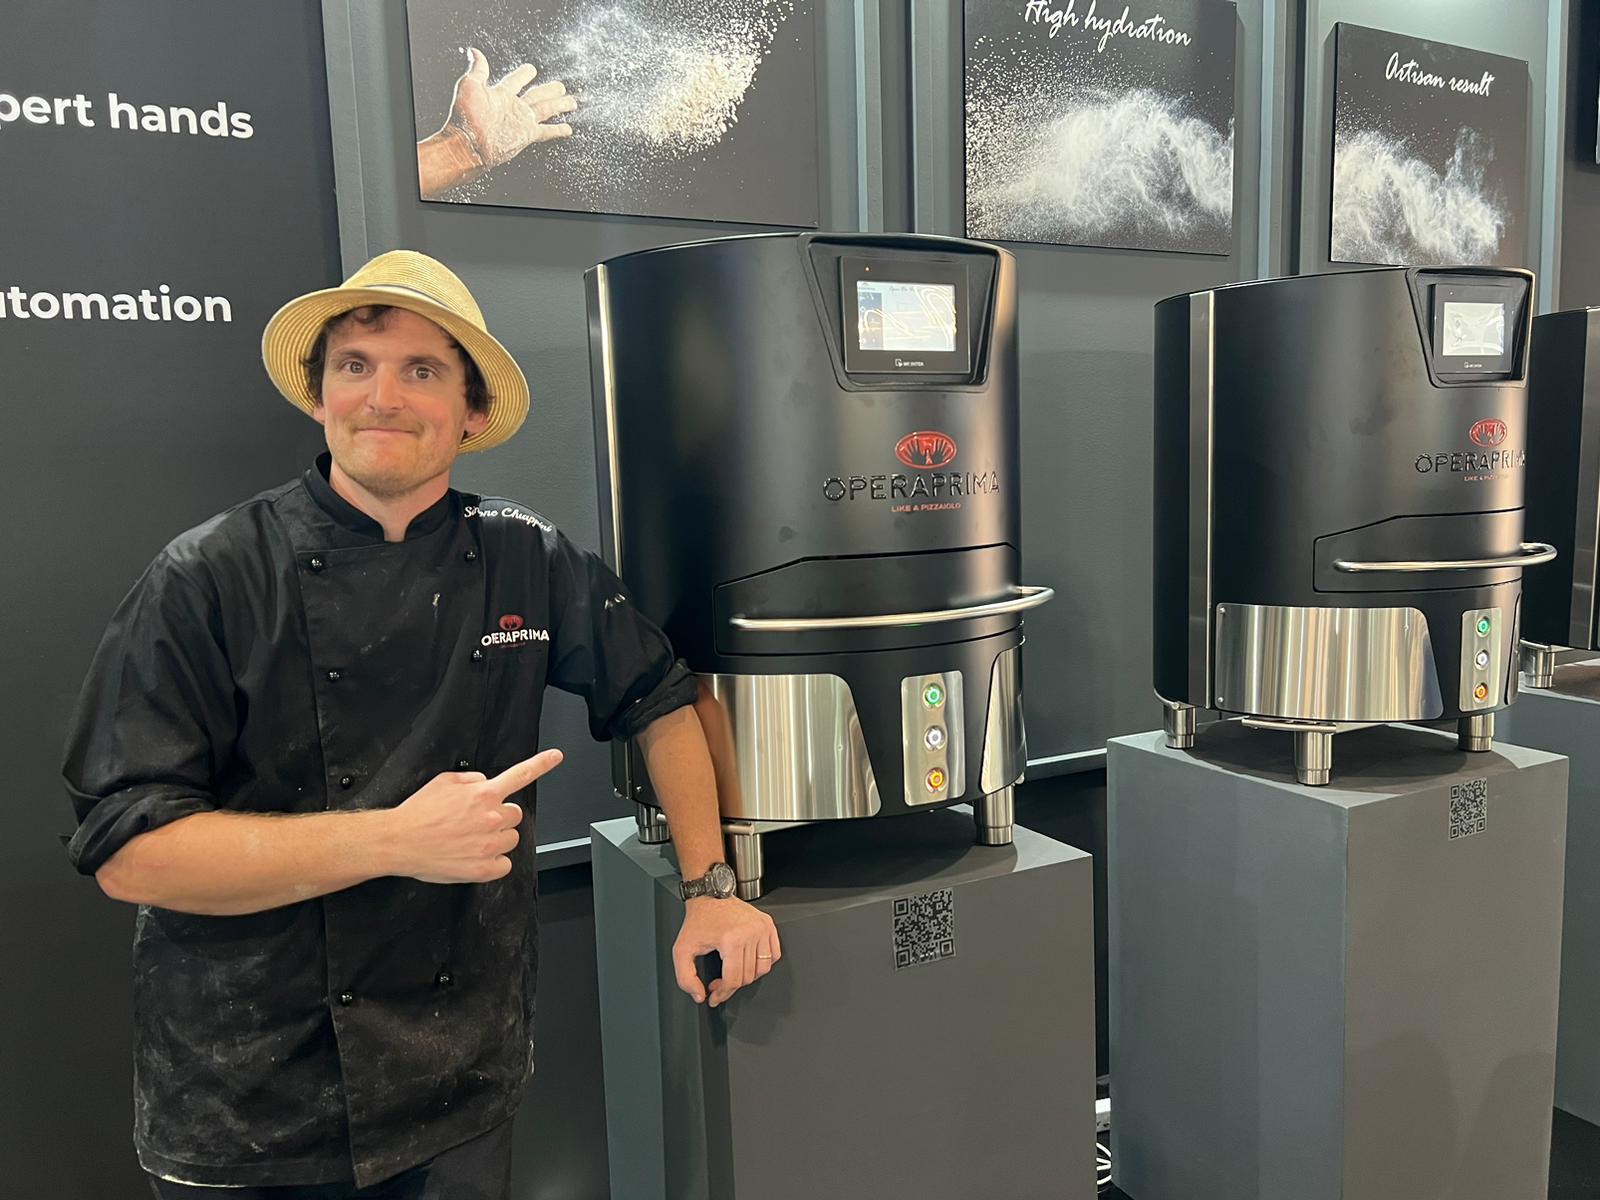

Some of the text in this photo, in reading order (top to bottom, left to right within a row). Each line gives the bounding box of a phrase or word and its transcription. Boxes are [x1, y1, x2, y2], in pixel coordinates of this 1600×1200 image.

[1024, 0, 1192, 53] High hydration
[1385, 51, 1495, 97] Artisan result
[0, 92, 254, 139] pert hands
[1415, 449, 1526, 473] OPERAPRI
[823, 471, 1000, 501] OPERAPRIMA
[891, 504, 911, 513] LIKE
[921, 502, 961, 511] PIZZAIOLO
